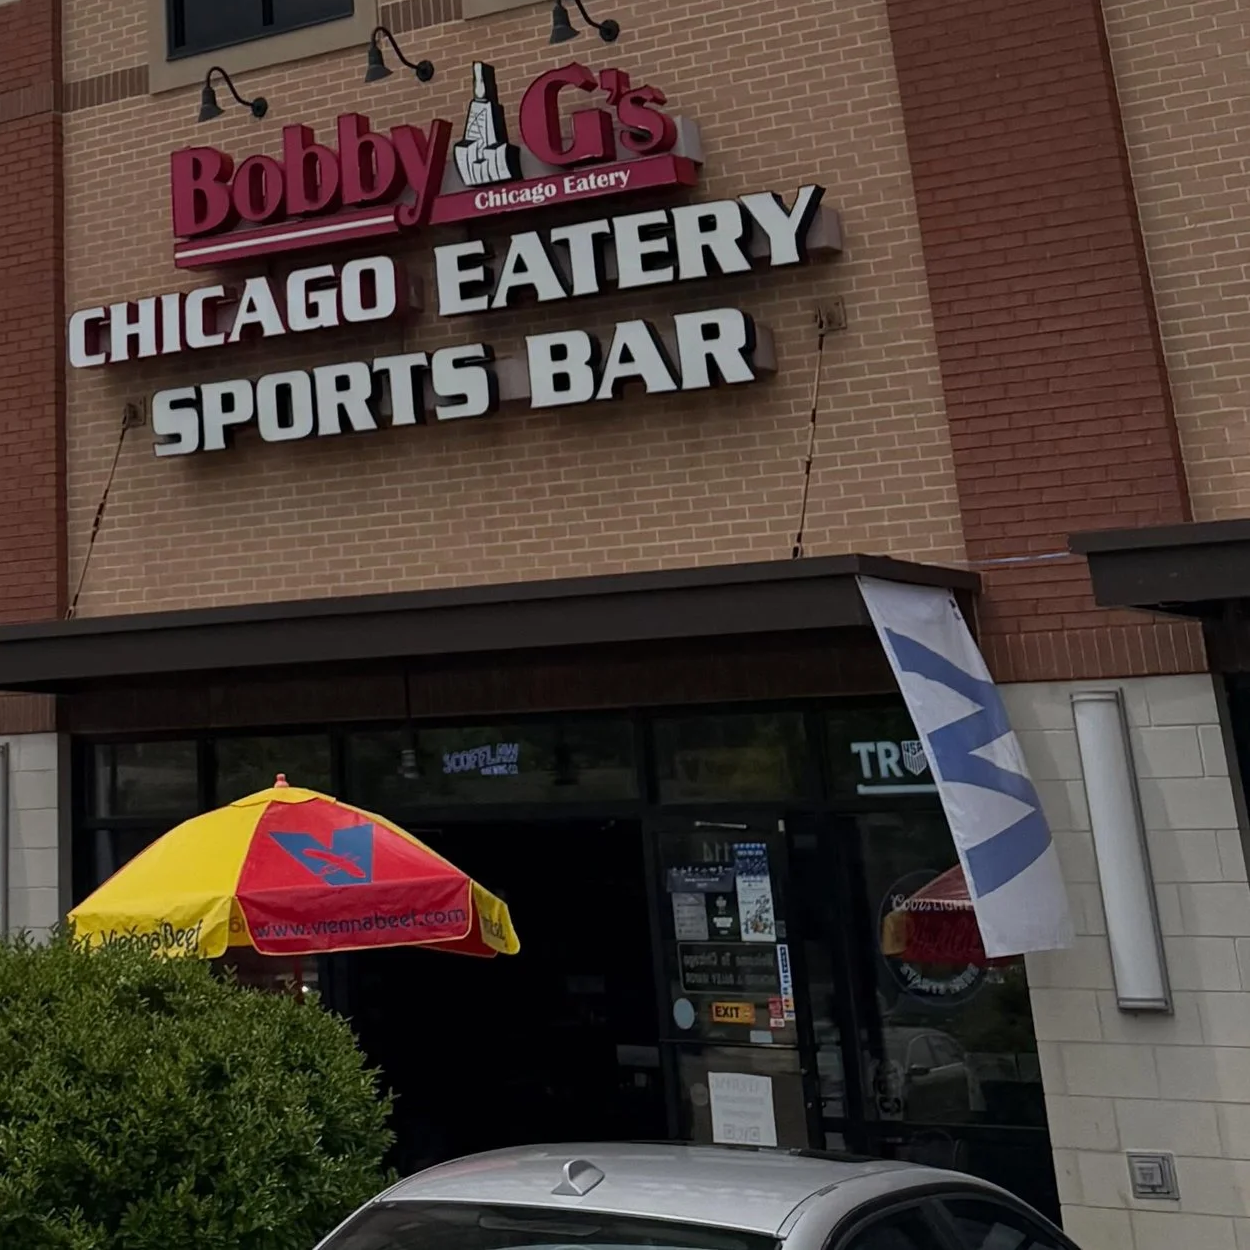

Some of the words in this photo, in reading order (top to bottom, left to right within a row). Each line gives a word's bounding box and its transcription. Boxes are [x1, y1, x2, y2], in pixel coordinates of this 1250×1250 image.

[170, 113, 452, 239] Bobby
[519, 61, 678, 166] G's
[475, 182, 557, 210] Chicago
[563, 169, 630, 194] Eatery
[68, 256, 400, 368] CHICAGO
[434, 184, 825, 317] EATERY
[152, 342, 493, 457] SPORTS
[526, 307, 756, 410] BAR
[162, 918, 203, 953] Beef
[256, 908, 466, 938] www.viennabeef.com
[715, 1005, 740, 1018] EXIT
